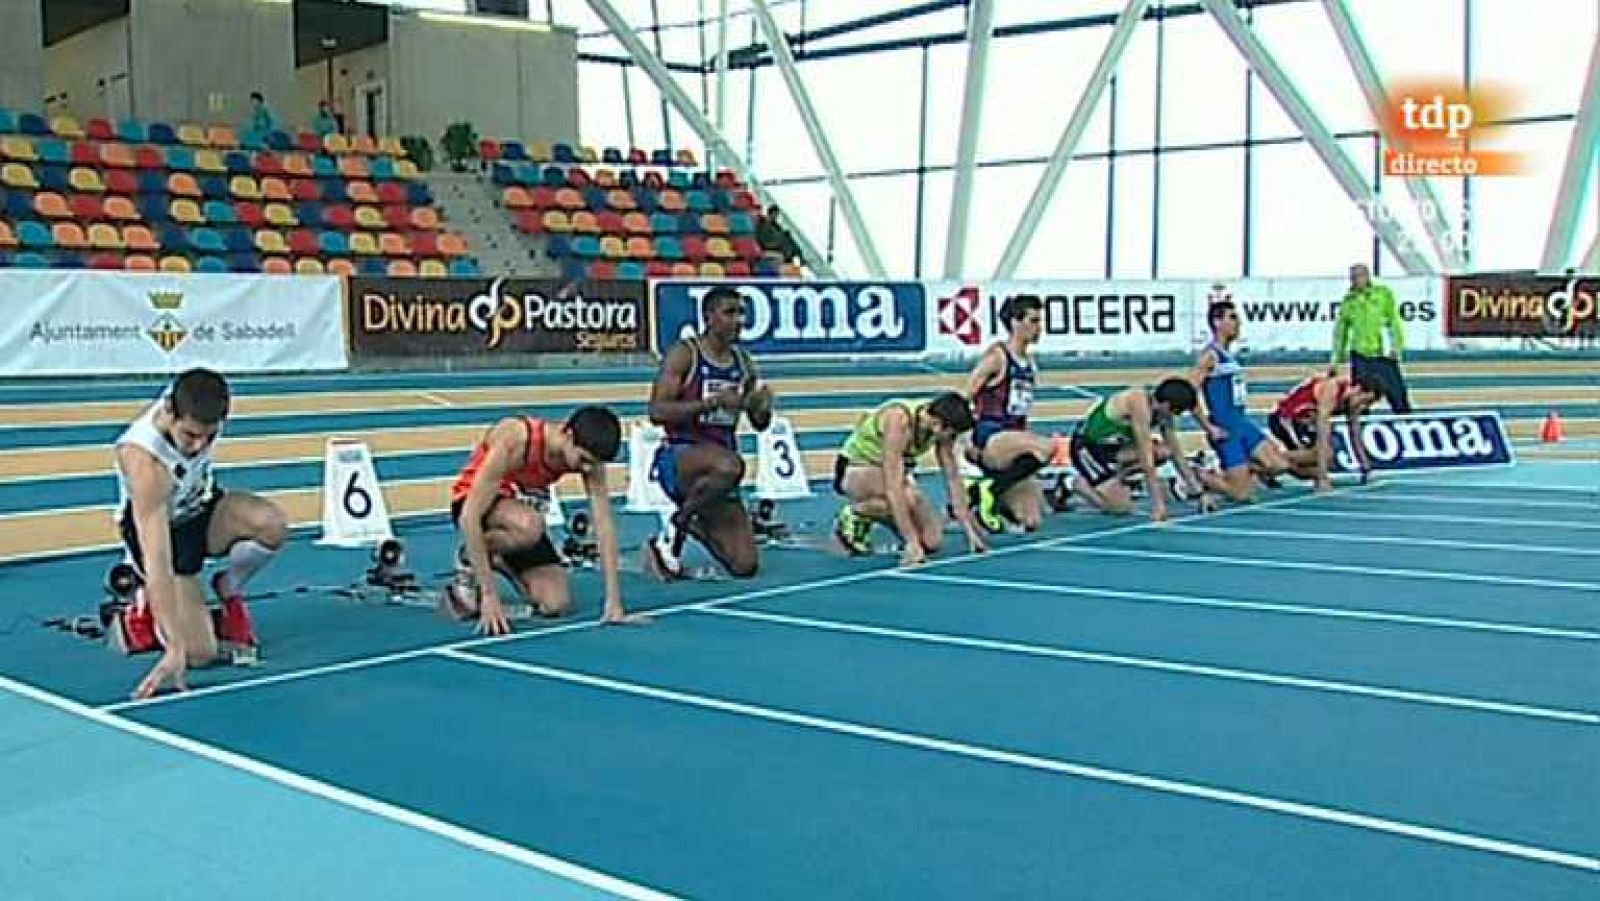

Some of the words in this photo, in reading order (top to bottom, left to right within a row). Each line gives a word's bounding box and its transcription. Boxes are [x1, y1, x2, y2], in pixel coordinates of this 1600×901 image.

[363, 294, 466, 332] Divina
[524, 294, 636, 329] Pastora
[989, 294, 1175, 335] KOCERA
[1459, 287, 1545, 318] Divina
[29, 320, 141, 344] Ajuntament
[193, 321, 215, 341] de
[221, 320, 296, 341] Sabadell
[773, 439, 795, 479] 3
[1334, 416, 1493, 472] Joma
[343, 470, 372, 519] 6
